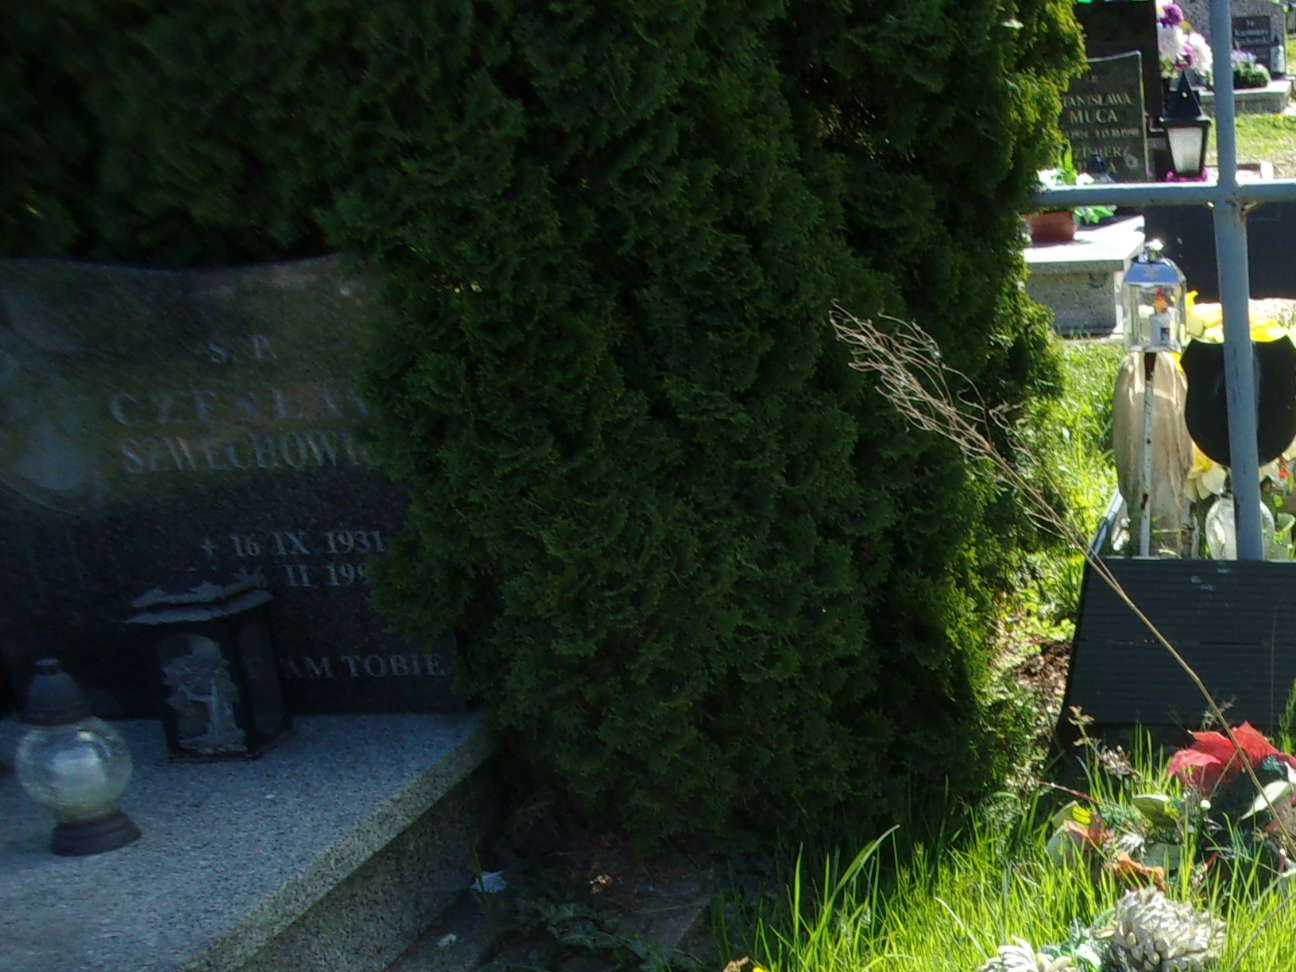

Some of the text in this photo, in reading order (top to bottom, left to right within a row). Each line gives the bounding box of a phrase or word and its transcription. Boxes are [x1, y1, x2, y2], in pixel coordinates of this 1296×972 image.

[230, 530, 385, 557] 16 IX 1931
[340, 653, 447, 678] TOBIE
